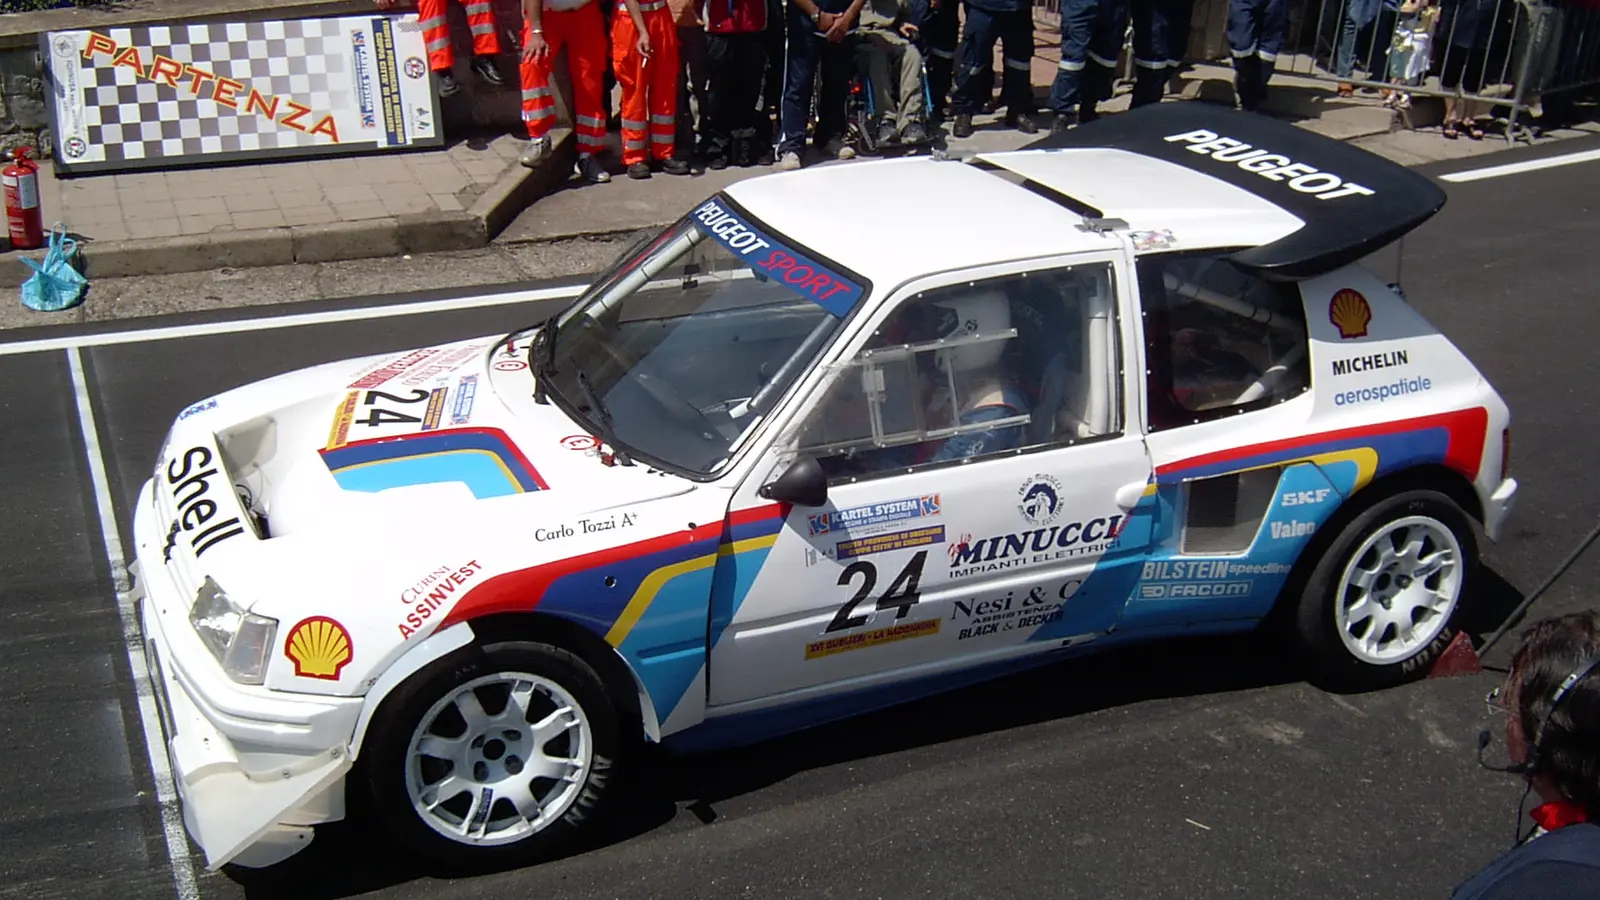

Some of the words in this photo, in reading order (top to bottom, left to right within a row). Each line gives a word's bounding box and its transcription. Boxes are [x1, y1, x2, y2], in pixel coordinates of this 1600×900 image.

[82, 31, 340, 144] PARTENZA
[1163, 129, 1376, 201] PEUGEOT
[694, 200, 770, 256] PEUGEOT
[757, 249, 852, 300] SPORT
[1332, 349, 1409, 376] MICHELIN
[355, 389, 430, 427] 24
[1334, 376, 1432, 406] aerospatiale
[167, 446, 245, 559] Shell
[831, 507, 873, 523] KARTEL
[875, 500, 918, 516] SYSTEM
[1281, 488, 1330, 506] SKF
[535, 524, 574, 542] Carlo
[578, 517, 616, 534] Tozzi
[951, 515, 1122, 567] MINUCCI
[1271, 520, 1316, 538] Valeo
[949, 558, 1027, 579] IMPIANTI
[1032, 539, 1121, 563] ELETTRICI
[1141, 560, 1229, 580] BILSTEIN
[397, 559, 483, 640] ASSINVEST
[400, 565, 451, 605] CURINI
[825, 550, 928, 634] 24
[1170, 579, 1250, 597] FACOM
[952, 591, 1013, 620] Nesi
[1022, 586, 1047, 607] &
[971, 602, 1064, 625] ASSISTENZA
[958, 622, 1000, 641] BLACK
[1002, 618, 1015, 631] &
[1017, 609, 1065, 629] DECKER
